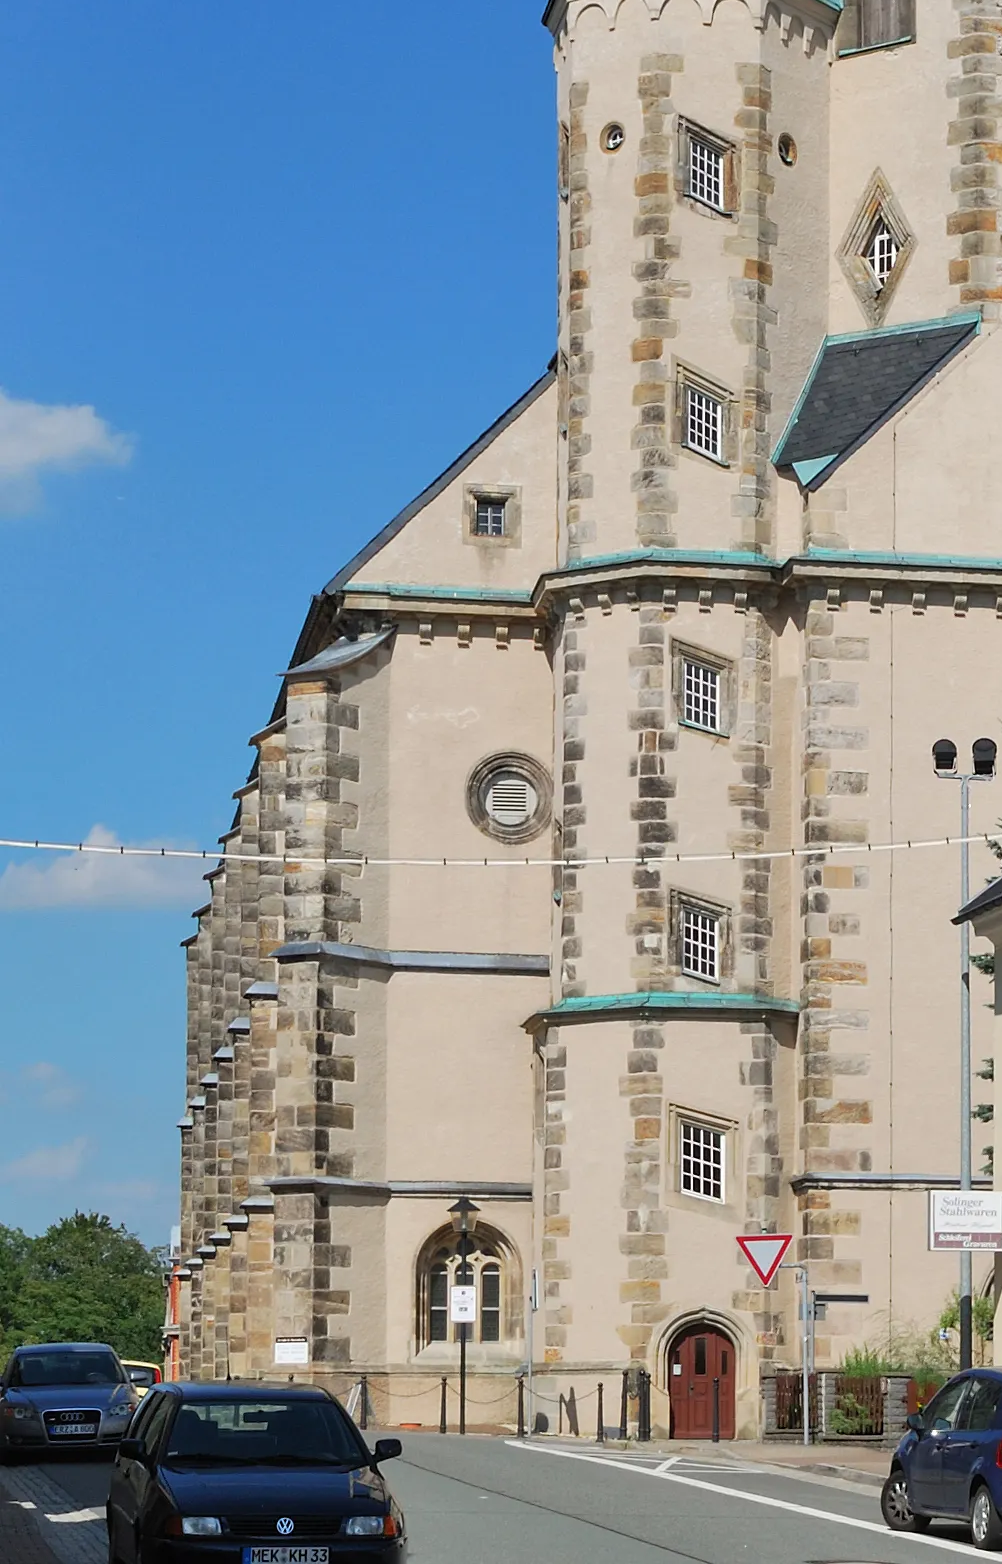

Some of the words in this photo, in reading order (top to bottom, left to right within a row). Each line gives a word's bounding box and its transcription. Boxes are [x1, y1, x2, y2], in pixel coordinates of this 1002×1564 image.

[942, 1196, 983, 1208] Solinger
[939, 1207, 998, 1217] Stahlwaren
[963, 1240, 998, 1249] Gravuren
[251, 1548, 279, 1563] MEK
[289, 1548, 308, 1563] KH
[310, 1548, 328, 1563] 33
